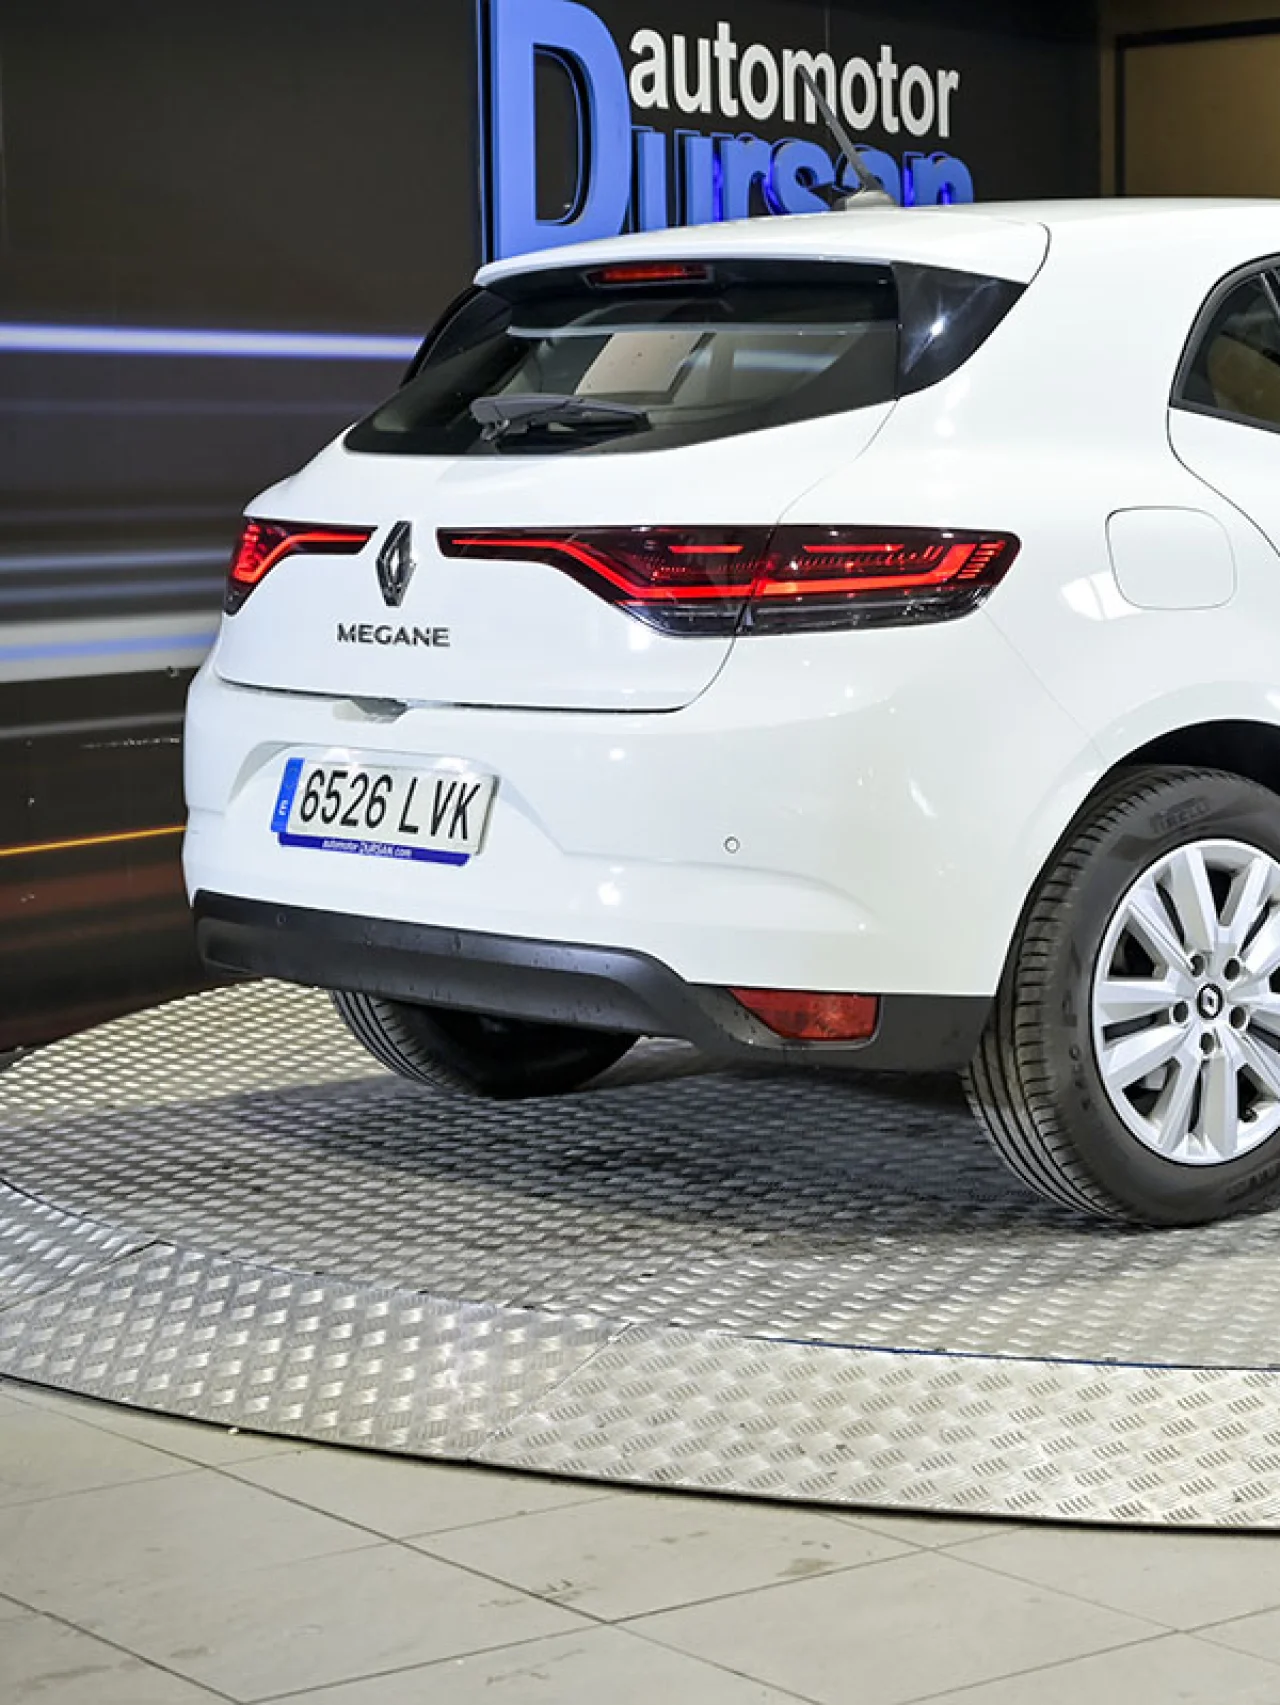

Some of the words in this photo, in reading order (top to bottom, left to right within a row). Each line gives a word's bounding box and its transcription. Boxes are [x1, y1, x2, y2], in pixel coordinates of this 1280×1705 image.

[629, 21, 960, 138] automotor
[336, 622, 451, 648] MEGANE
[300, 767, 393, 829] 6526
[398, 776, 482, 841] LVK
